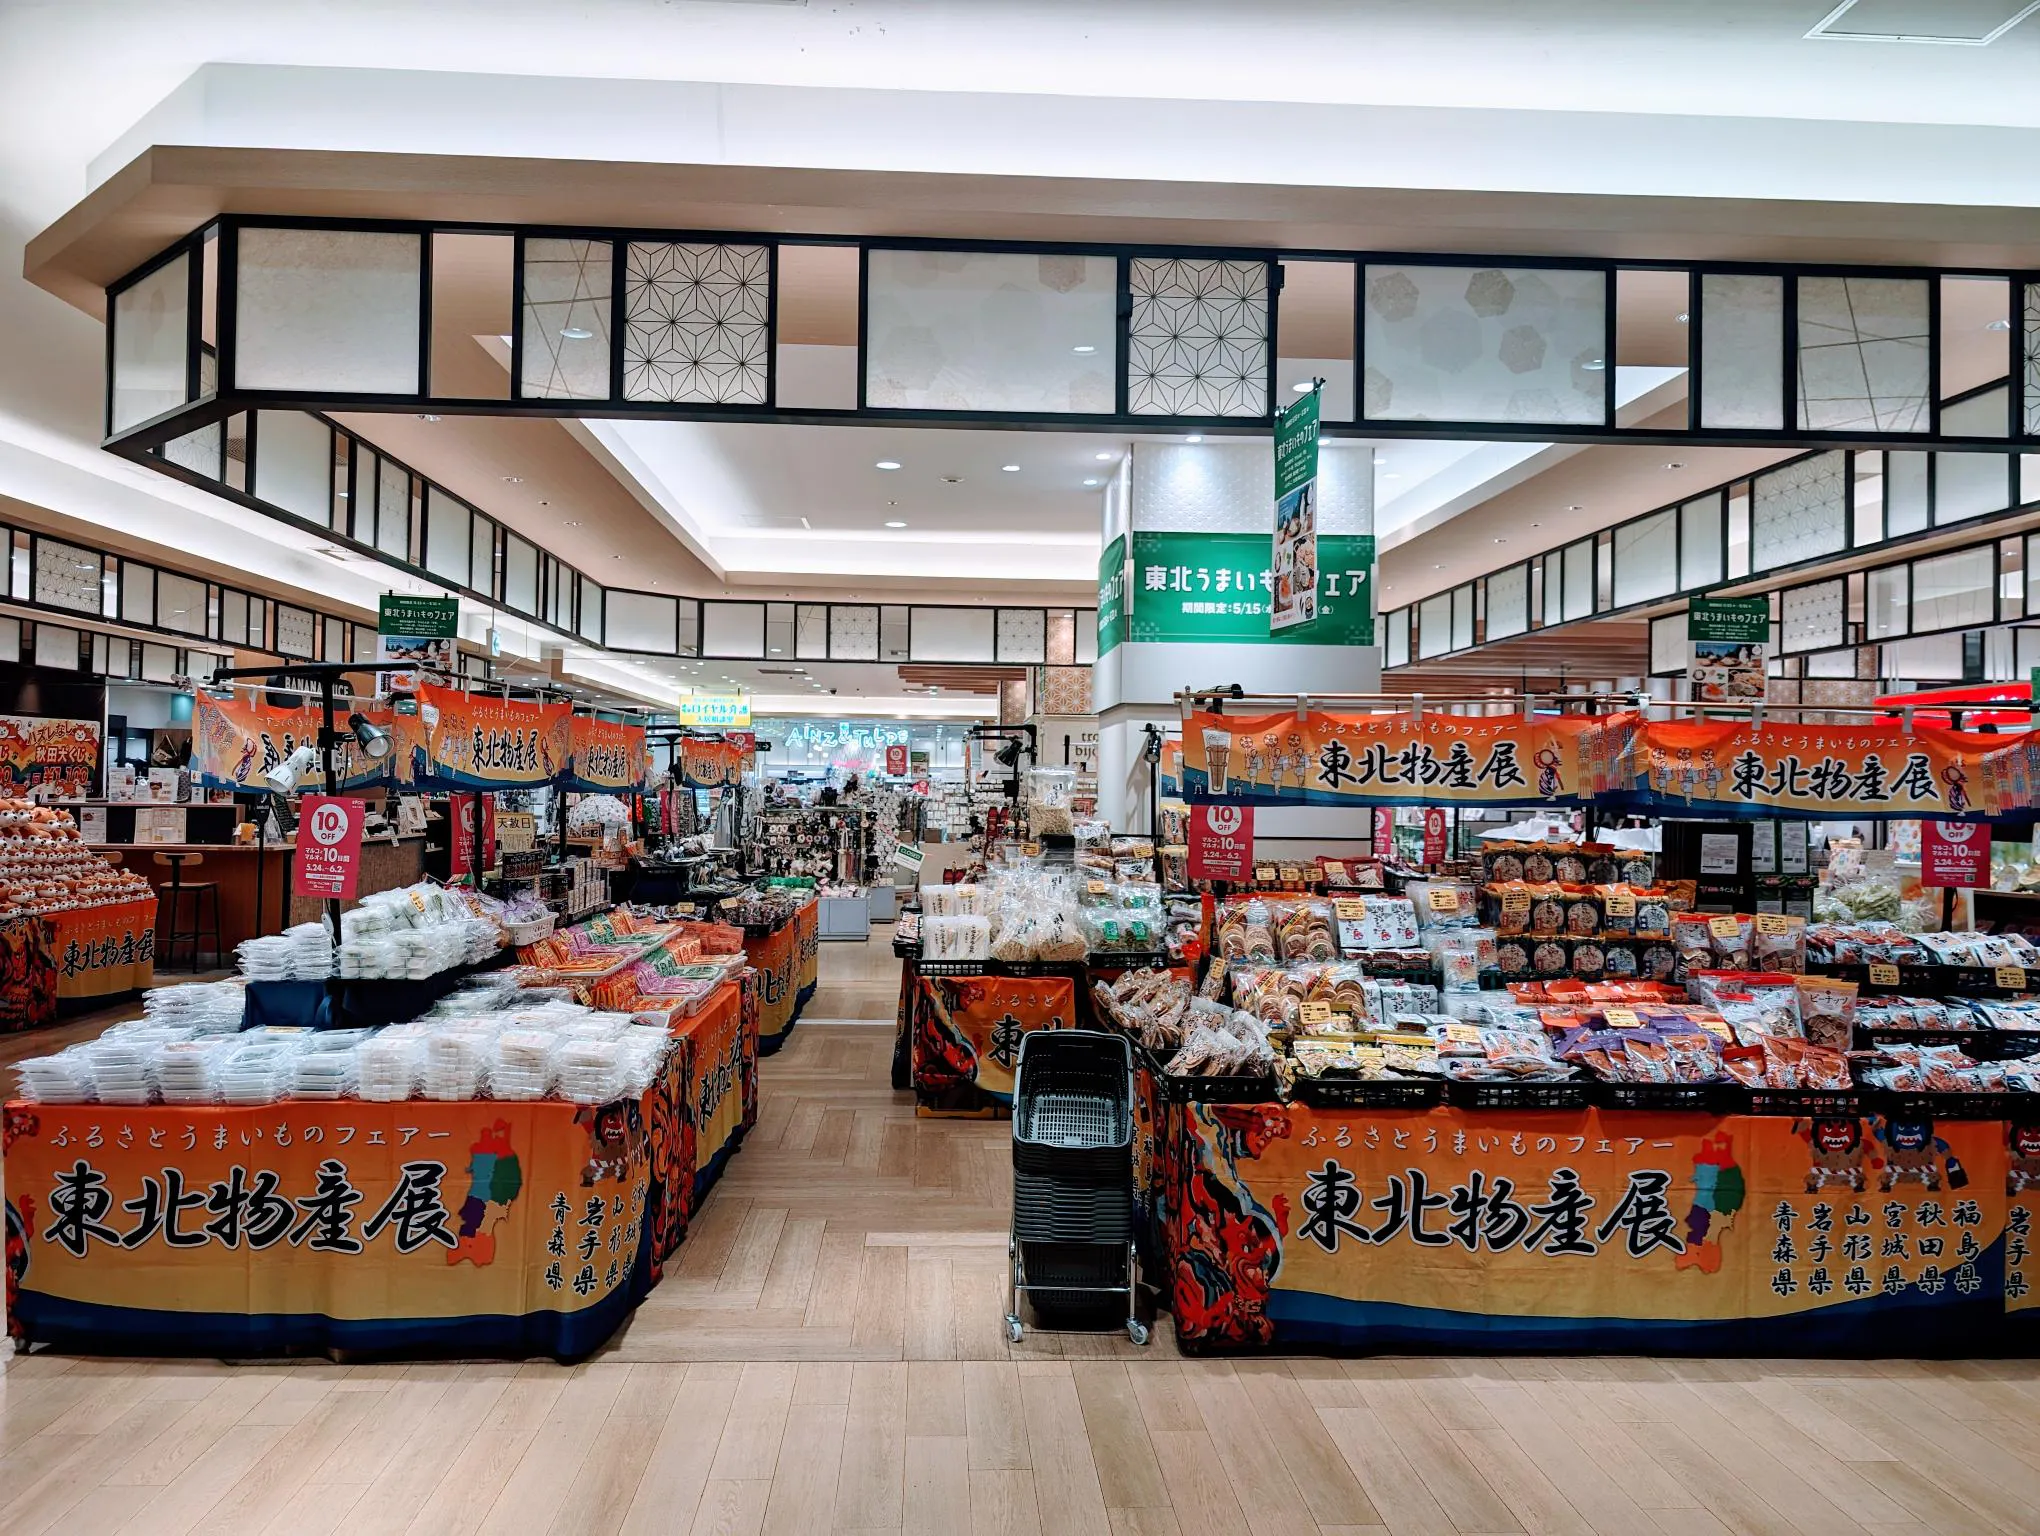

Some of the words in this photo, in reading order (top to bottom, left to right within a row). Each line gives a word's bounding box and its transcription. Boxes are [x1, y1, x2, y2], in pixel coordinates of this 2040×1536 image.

[384, 608, 454, 620] 東北うまいものフェア
[1693, 612, 1767, 624] 東北うまいものフェア
[28, 721, 72, 745] ハズレなし
[36, 745, 86, 763] 秋田犬くじ
[472, 723, 539, 772] 東北物産展
[785, 726, 838, 747] AINZ
[1317, 720, 1519, 737] ふるさとうまいものフェアー
[1731, 734, 1928, 750] ふるさとうまいものフェアー
[587, 745, 626, 778] 東北物産展
[1316, 738, 1528, 790] 東北物産展
[1730, 749, 1941, 802] 東北物産展
[497, 817, 531, 828] 天赦日
[900, 847, 921, 860] CLOSED
[60, 928, 155, 979] 東北物産展
[49, 1122, 452, 1151] ふるさとうまいものフェアー
[1301, 1126, 1675, 1156] ふるさとうまいものフェアー
[43, 1158, 460, 1258] 東北物産展
[1297, 1158, 1687, 1258] 東北物産展
[545, 1191, 573, 1292] 青森県
[573, 1195, 607, 1297] 岩手県
[605, 1195, 625, 1289] 山形県
[1771, 1201, 1799, 1297] 青森県
[1807, 1203, 1834, 1296] 岩手県
[1843, 1203, 1874, 1296] 山形県
[1880, 1200, 1911, 1296] 宮城県
[1915, 1201, 1948, 1296] 秋田県
[1952, 1200, 1984, 1295] 福島県
[2004, 1206, 2033, 1299] 岩手県
